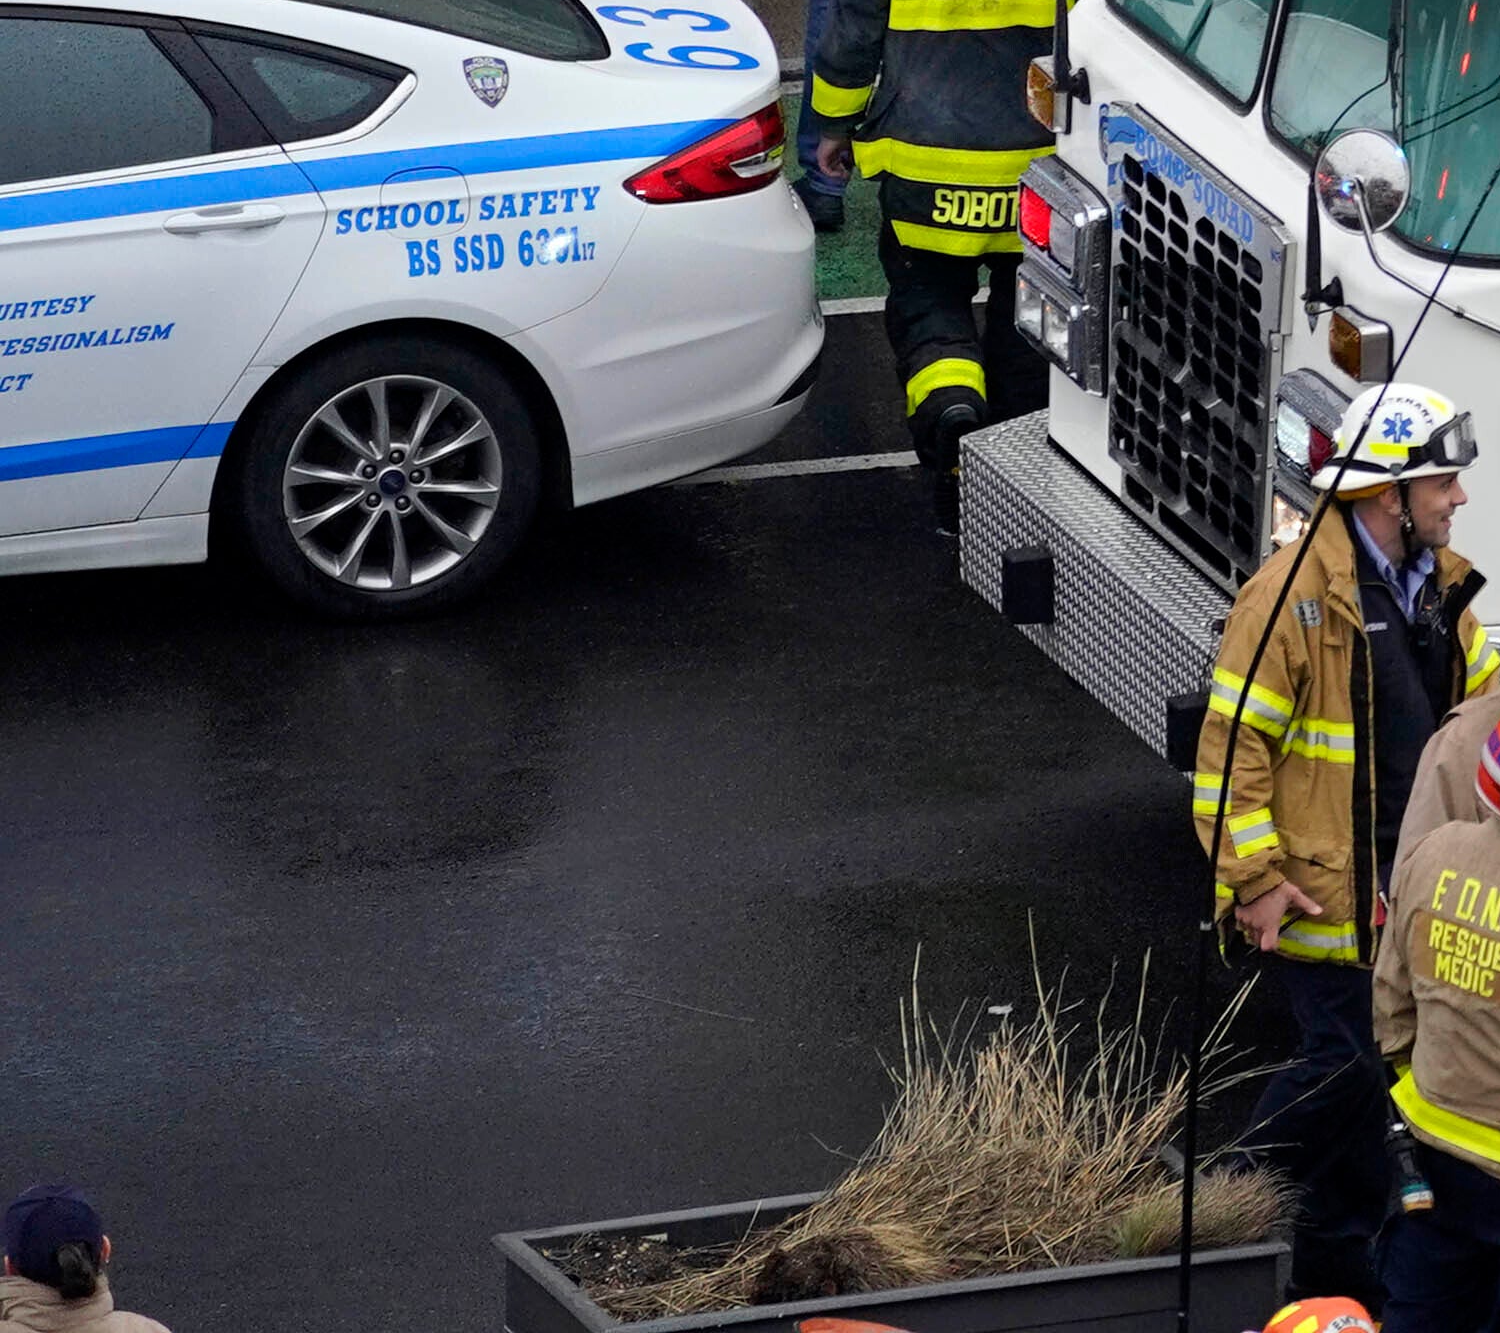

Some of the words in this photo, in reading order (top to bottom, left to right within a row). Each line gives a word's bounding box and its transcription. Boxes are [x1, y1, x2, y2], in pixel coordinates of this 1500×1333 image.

[335, 198, 465, 236] SCHOOL
[478, 185, 601, 221] SAFETY
[406, 238, 441, 278] BS
[454, 233, 504, 273] SSD
[1435, 951, 1495, 998] MEDIC
